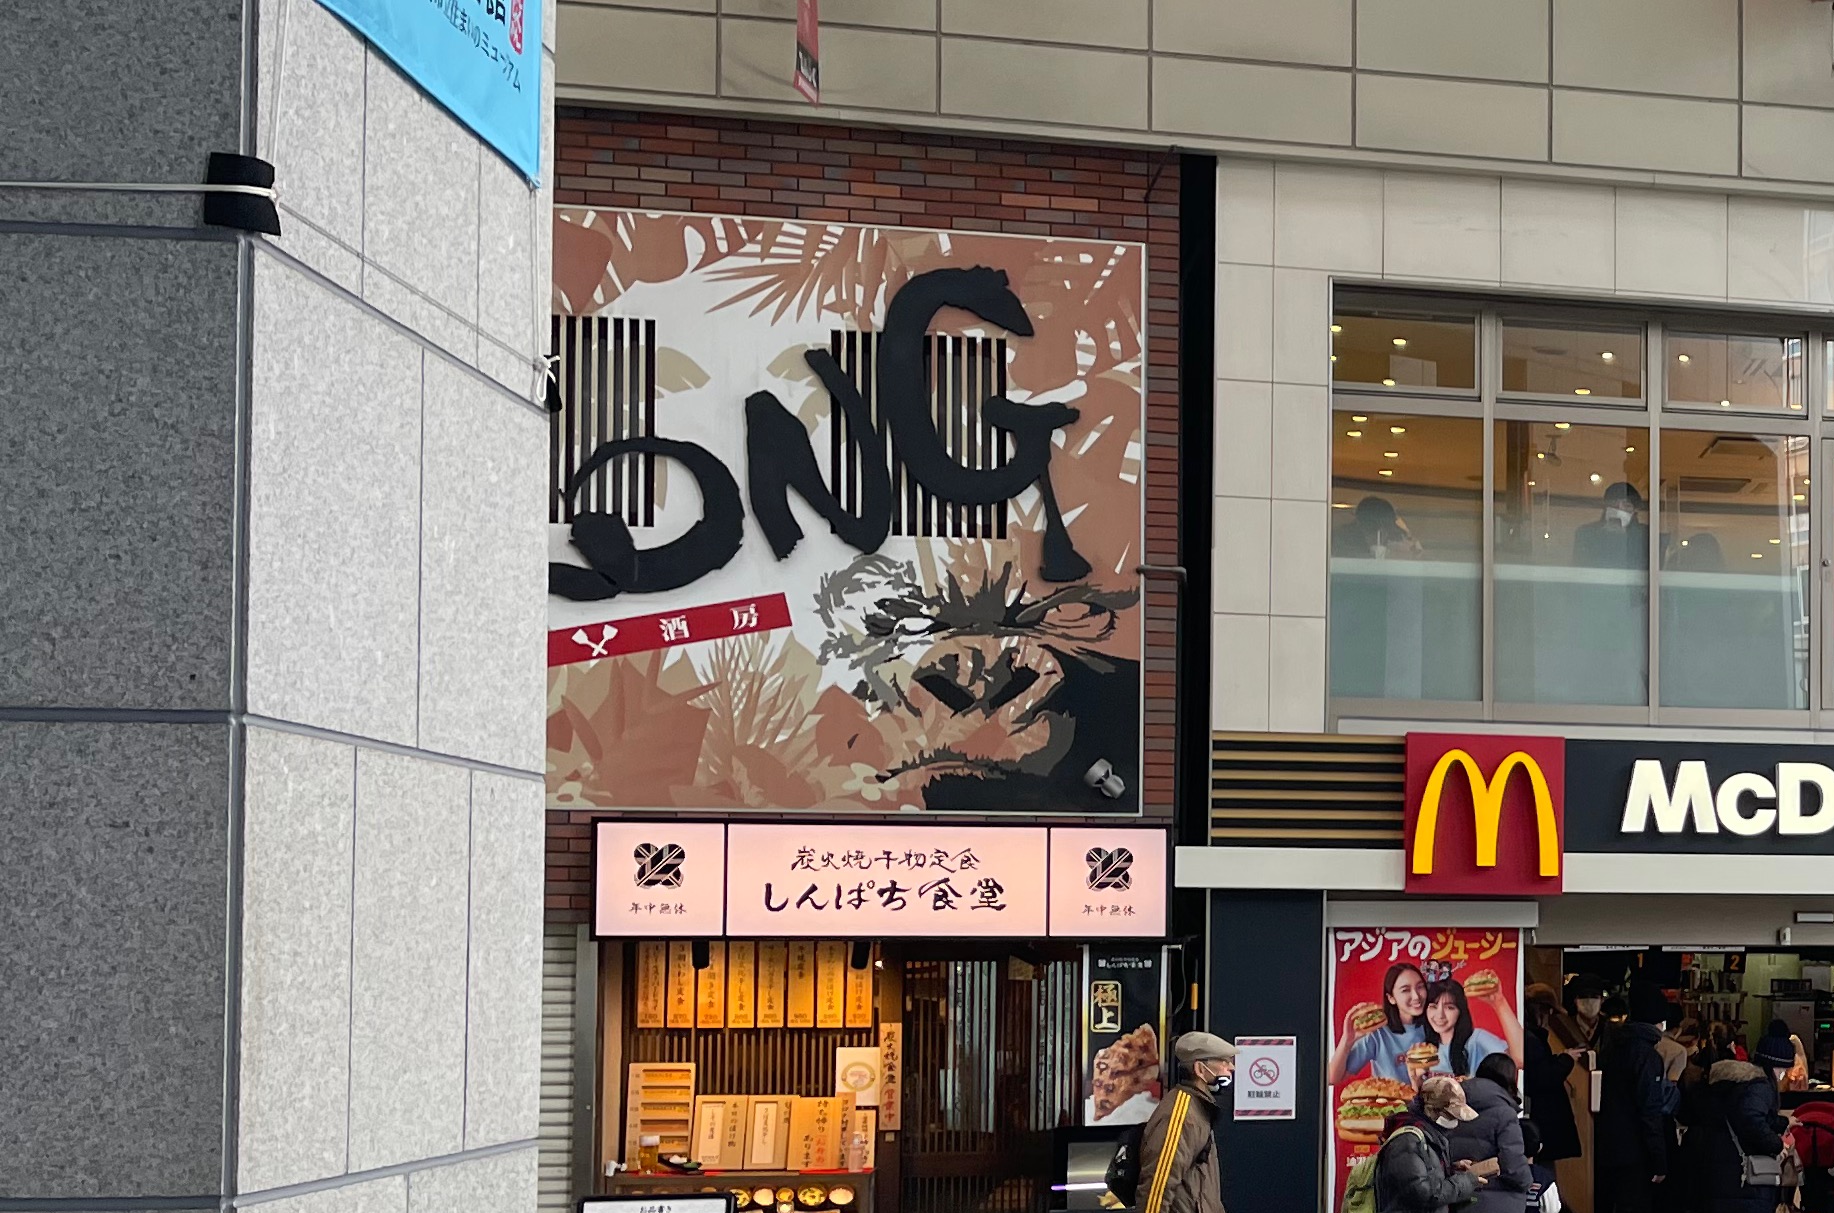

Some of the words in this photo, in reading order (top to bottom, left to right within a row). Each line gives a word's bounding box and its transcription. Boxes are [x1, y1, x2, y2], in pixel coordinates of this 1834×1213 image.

[548, 265, 1092, 601] ONG
[790, 845, 981, 873] 炭火焼干物定食
[628, 902, 687, 916] 年中無休
[764, 876, 1007, 912] しんぱち食堂
[1081, 903, 1136, 916] 年中無休
[1335, 927, 1517, 963] アジアのジューシー
[1730, 955, 1739, 971] 2
[1092, 983, 1120, 1030] 極上
